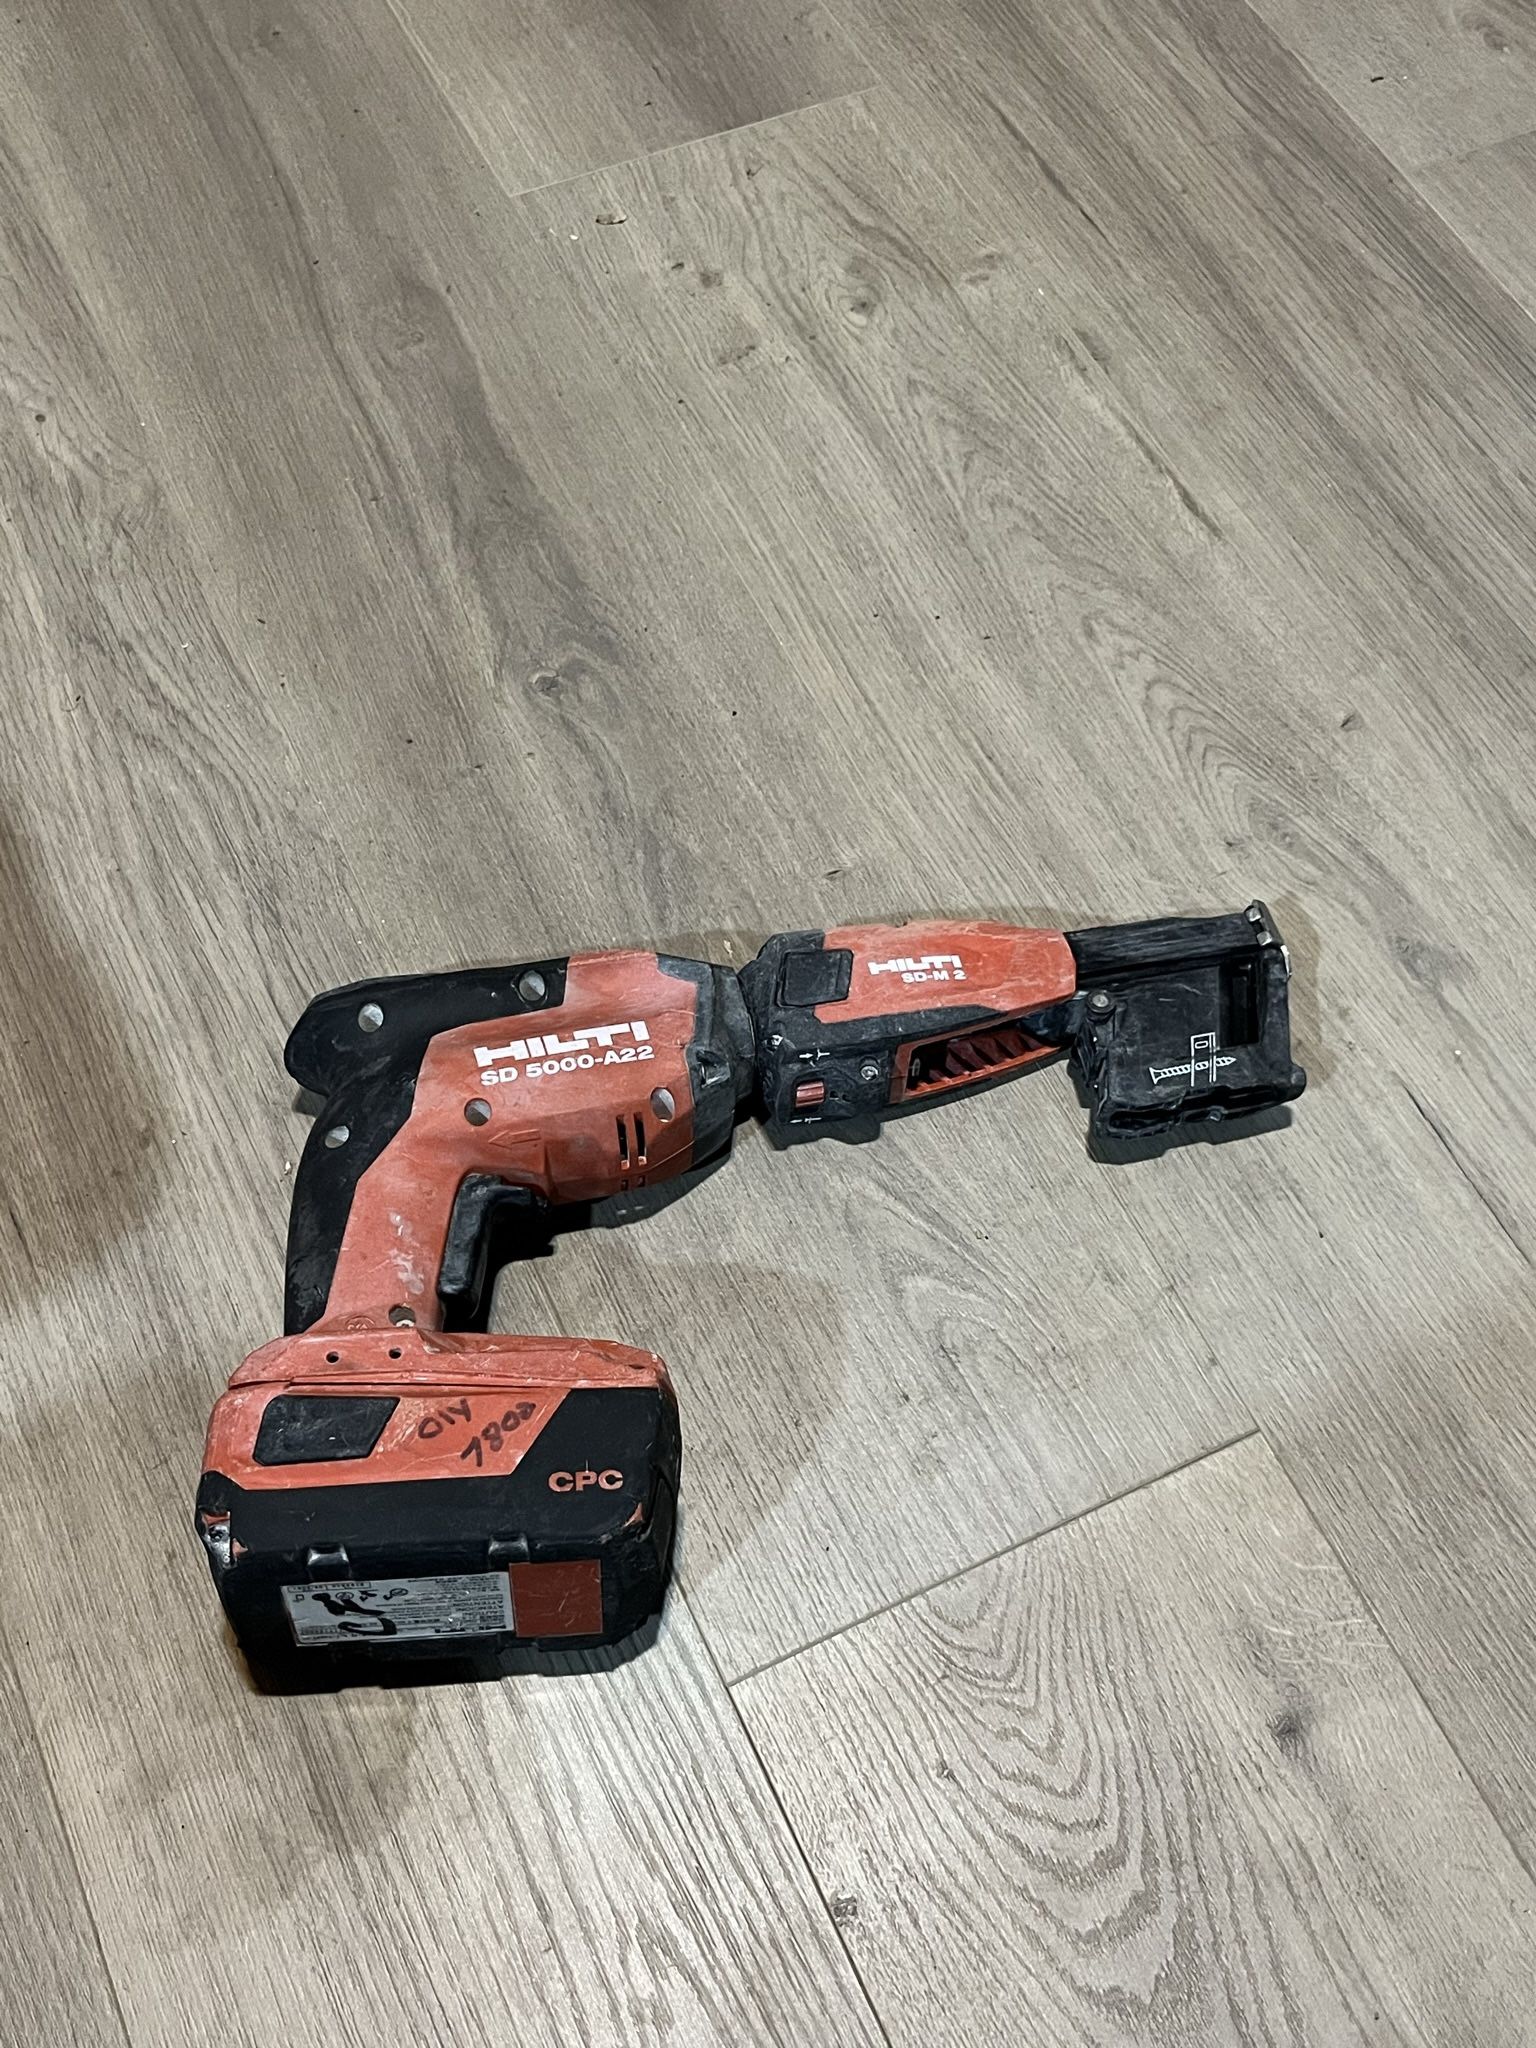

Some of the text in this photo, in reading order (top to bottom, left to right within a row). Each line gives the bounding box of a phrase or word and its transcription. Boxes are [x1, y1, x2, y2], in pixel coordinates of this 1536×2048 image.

[868, 954, 963, 975] HILTI
[901, 969, 967, 984] SD-M 2
[473, 1020, 651, 1068] HILTI
[480, 1045, 656, 1086] SD 5000-A22
[547, 1469, 624, 1492] CPC
